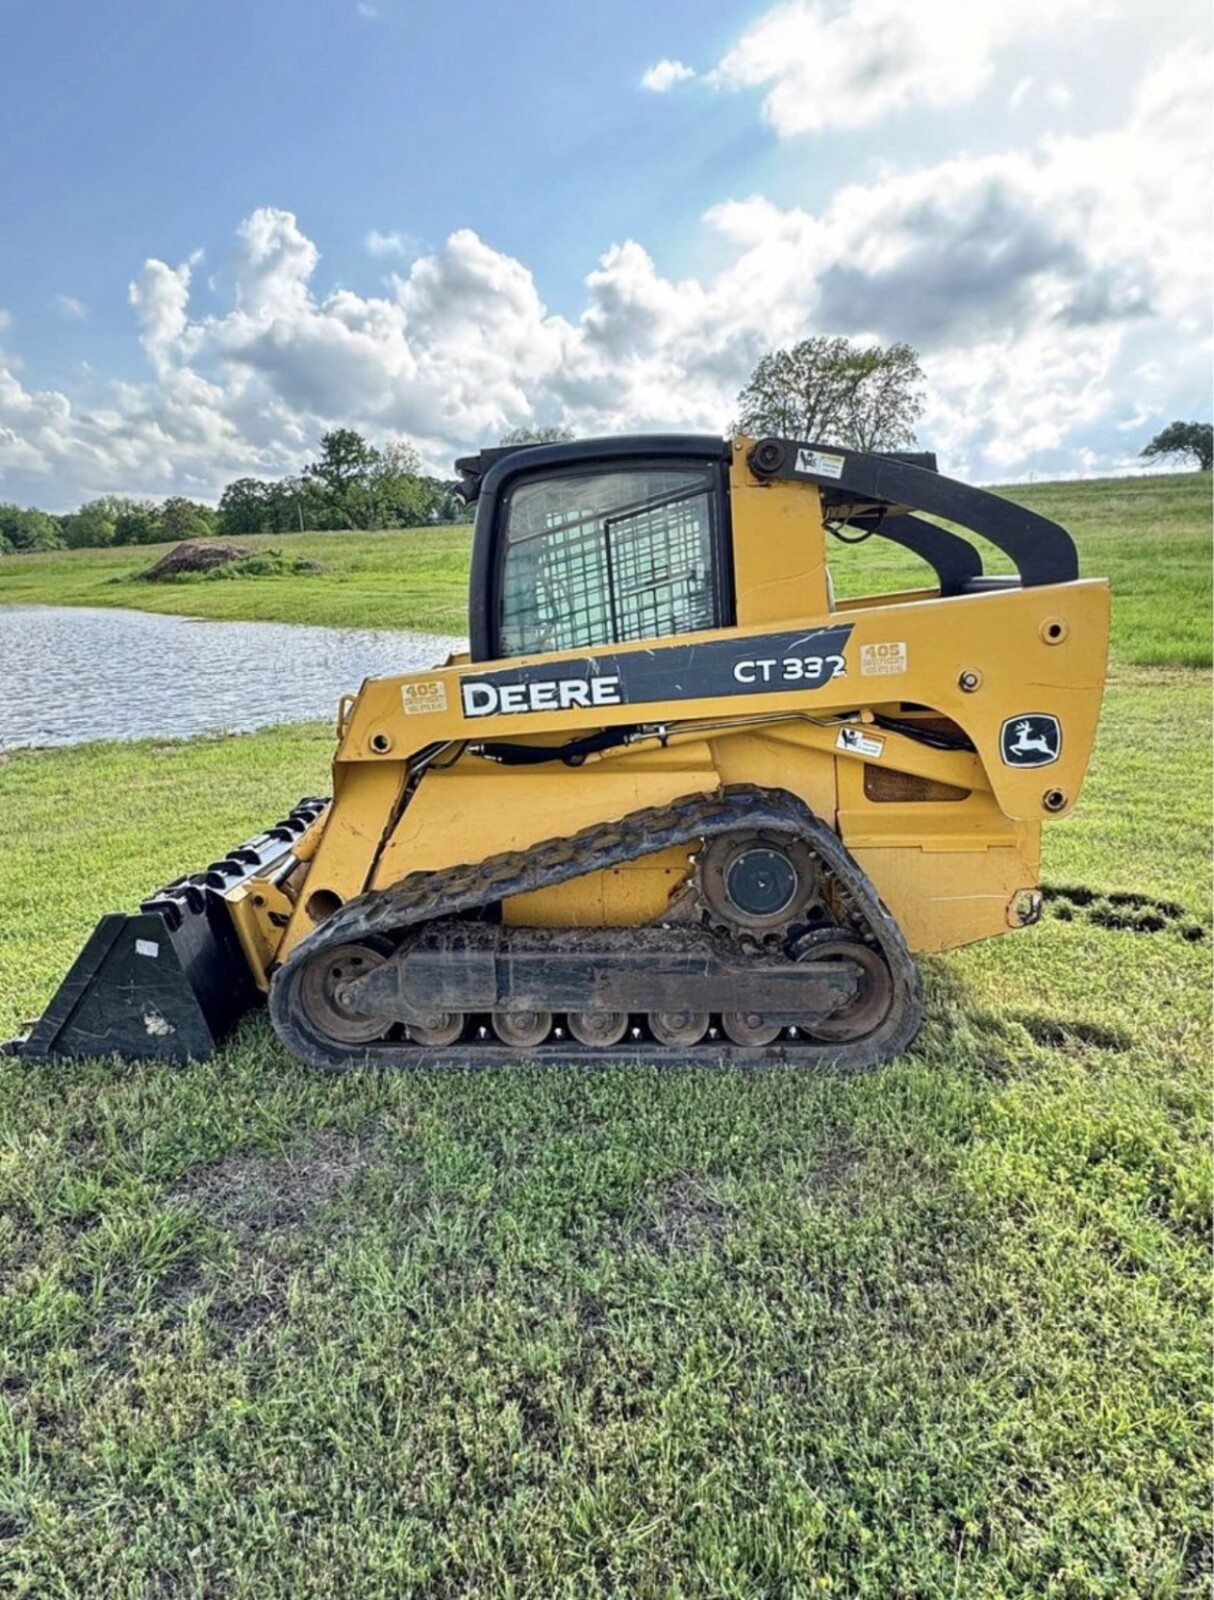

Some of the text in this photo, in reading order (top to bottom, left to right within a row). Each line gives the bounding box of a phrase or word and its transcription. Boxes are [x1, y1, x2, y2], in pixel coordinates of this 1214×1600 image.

[865, 644, 900, 658] 405
[733, 655, 847, 683] CT 332
[405, 683, 439, 698] 405
[462, 676, 621, 717] DEERE
